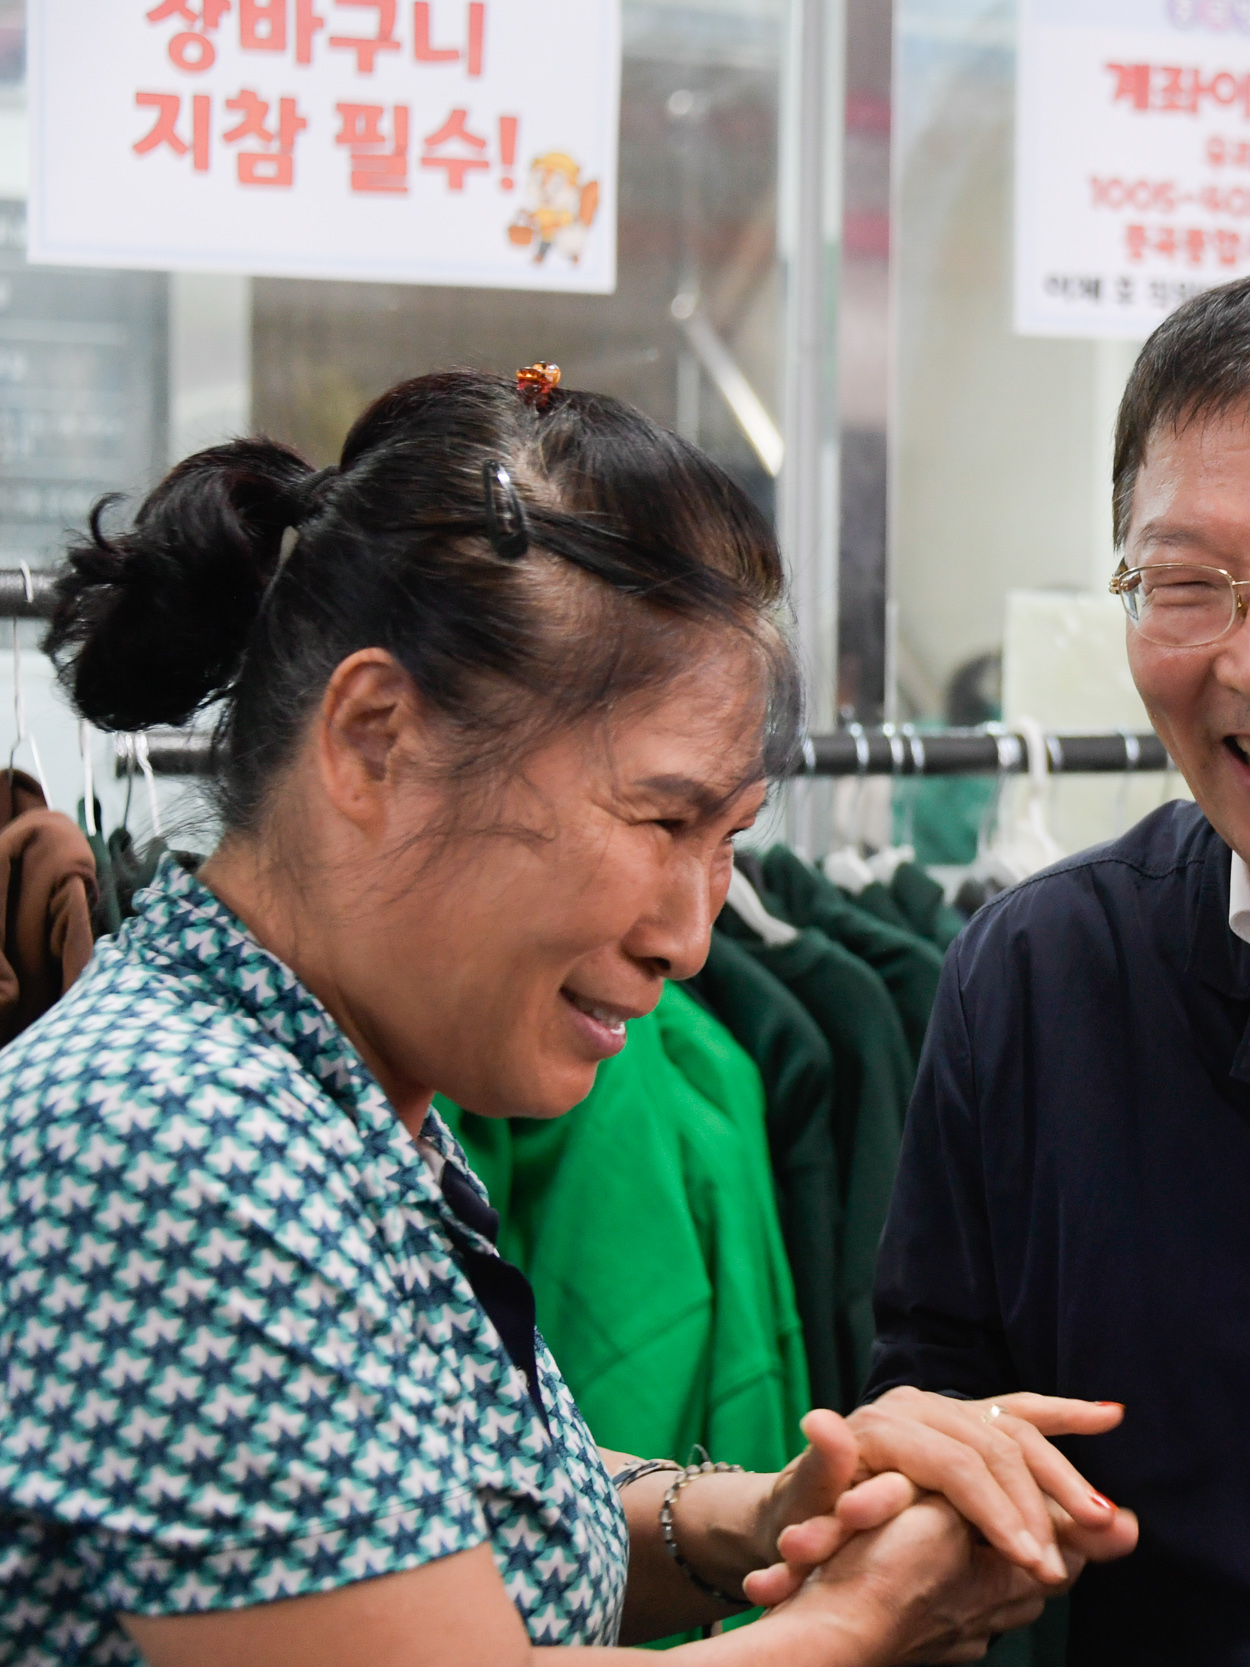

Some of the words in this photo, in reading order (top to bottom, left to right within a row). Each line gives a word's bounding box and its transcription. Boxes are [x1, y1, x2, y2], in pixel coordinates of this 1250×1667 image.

[145, 0, 487, 77] 장바구니
[132, 89, 308, 188] 지참
[334, 102, 518, 194] 필수!
